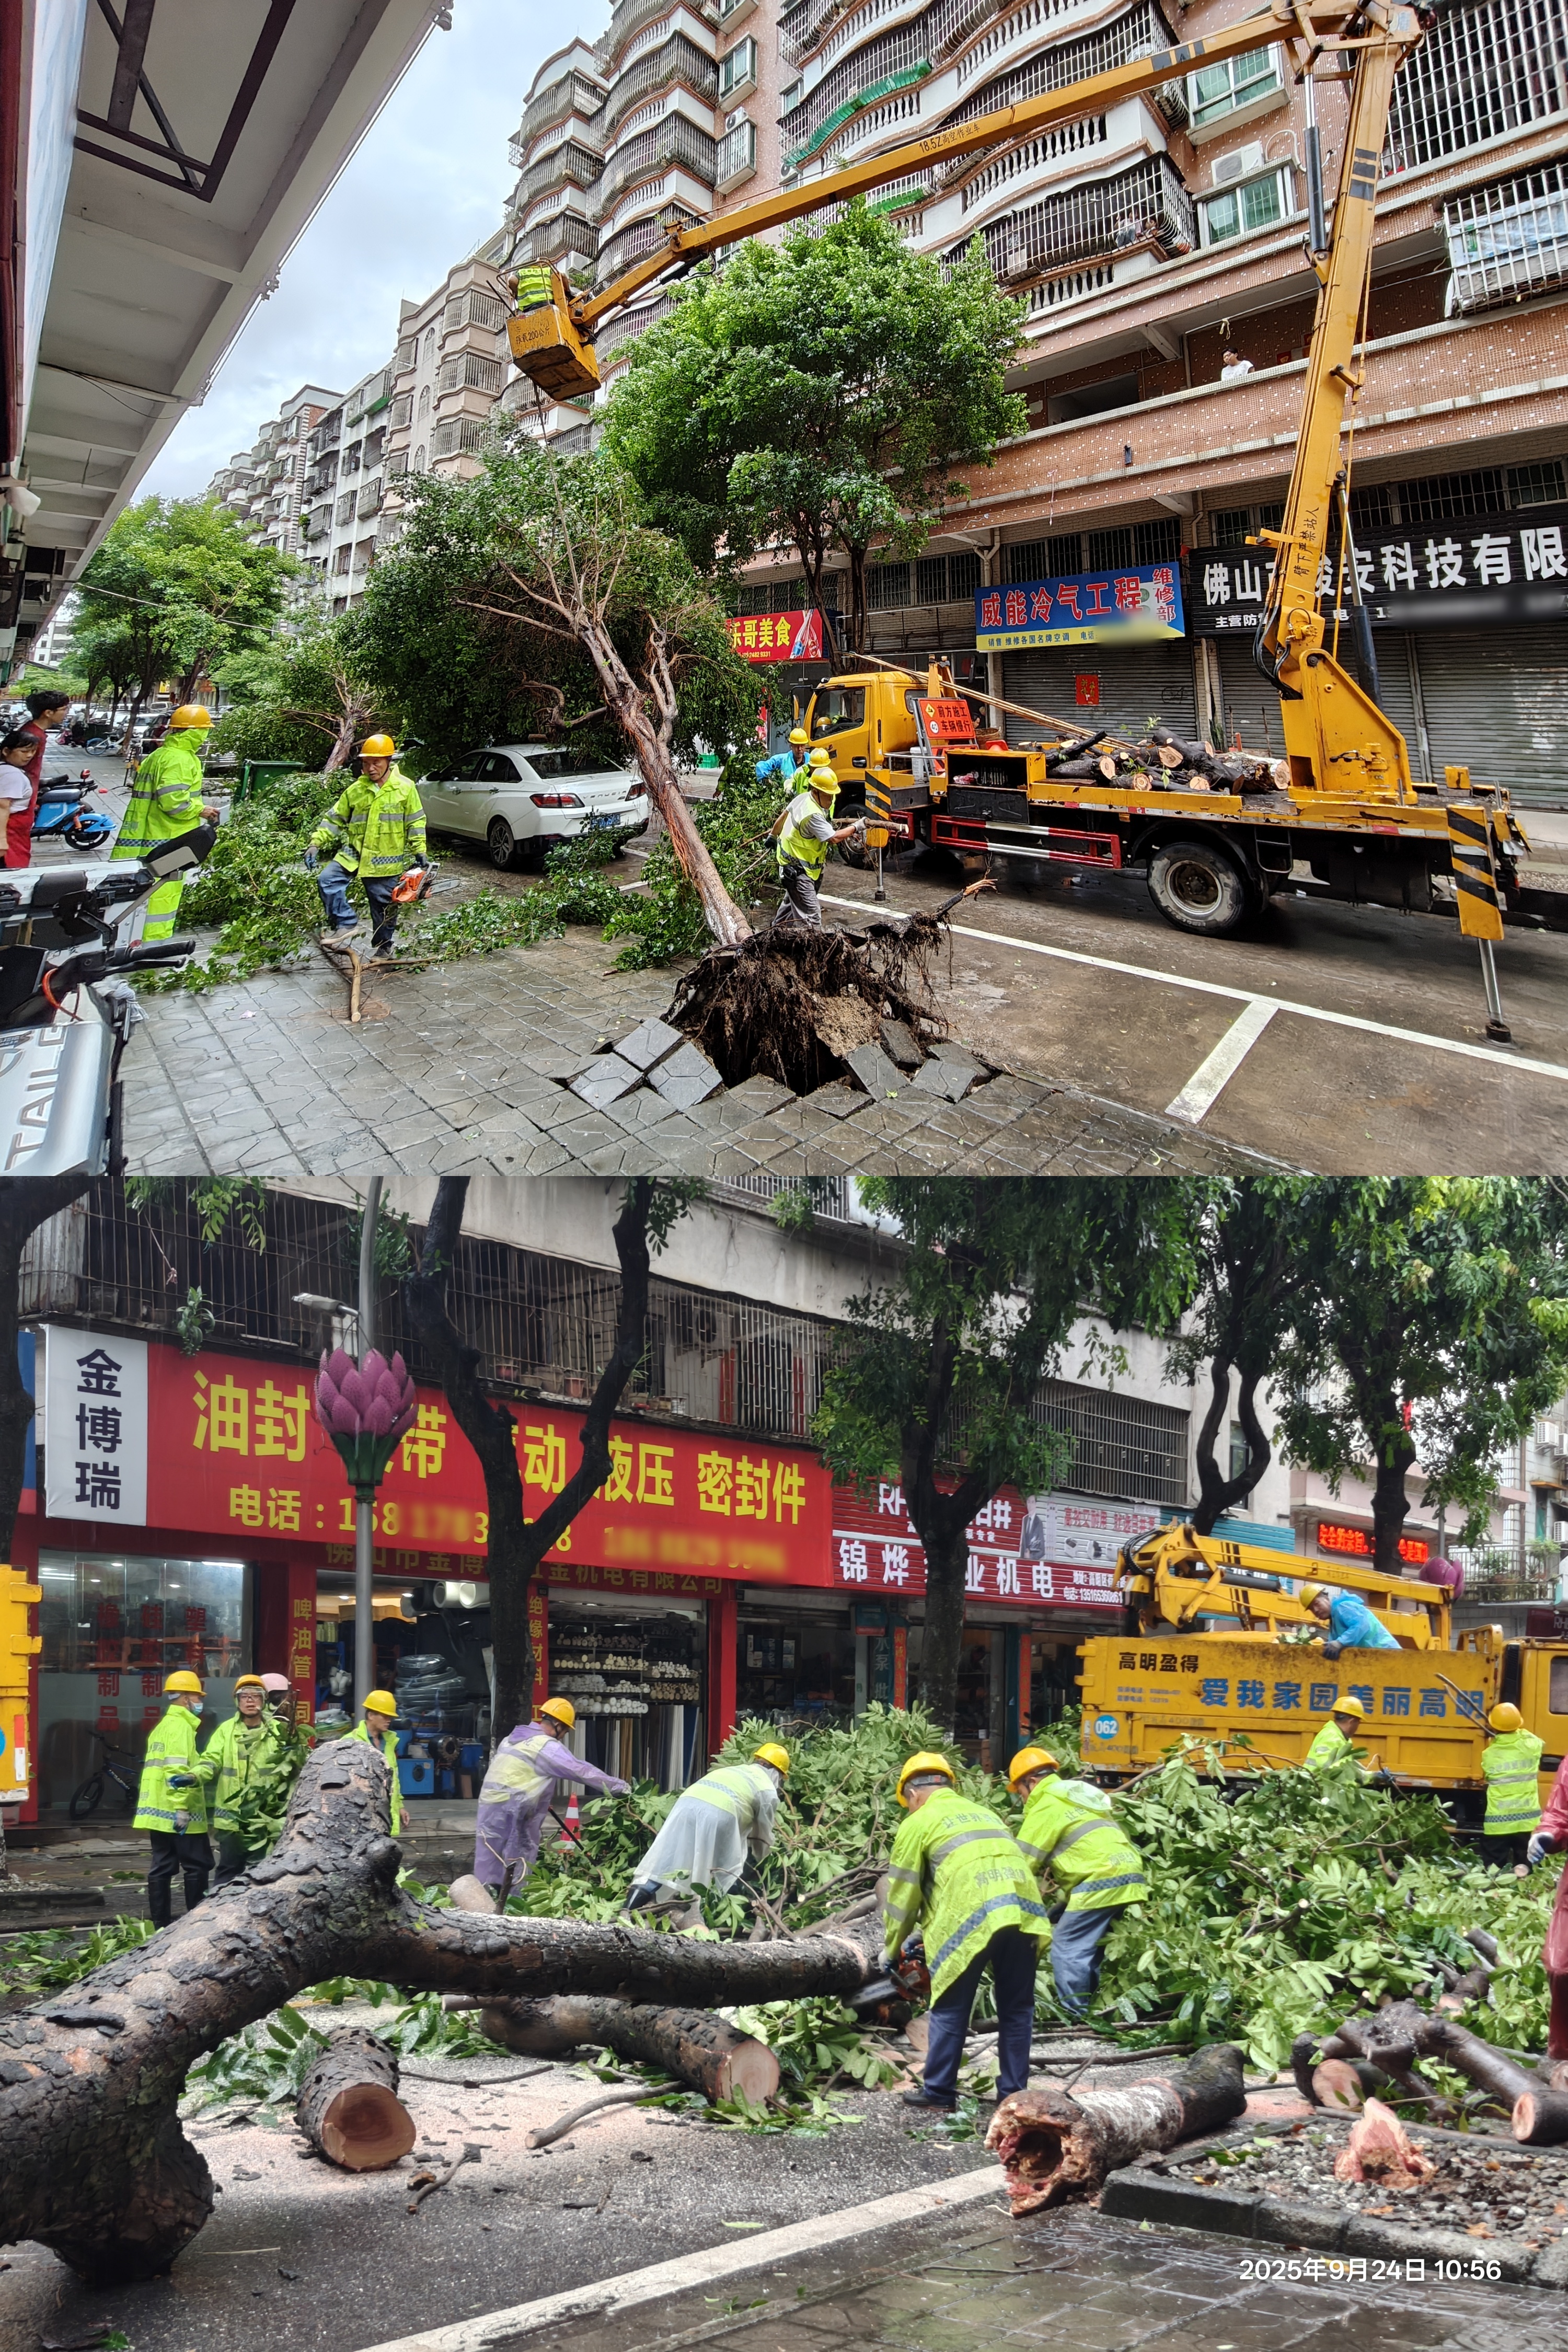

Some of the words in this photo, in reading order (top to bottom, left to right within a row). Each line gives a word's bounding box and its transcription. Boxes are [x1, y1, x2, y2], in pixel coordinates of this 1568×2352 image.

[919, 123, 980, 153] 18.5Z高空作业车
[1203, 526, 1567, 606] 佛山安科技有限
[1293, 506, 1320, 577] 臂下严禁站人
[981, 575, 1144, 627] 威能冷气工程
[1152, 567, 1177, 623] 维修部
[937, 705, 968, 718] 前方施工
[940, 719, 970, 732] 车辆慢行
[75, 1348, 122, 1510] 金博瑞
[192, 1370, 310, 1462] 油封
[594, 1434, 674, 1506] 液压
[697, 1450, 806, 1525] 密封件
[325, 1543, 723, 1594] 佛山市金博金机电有限公司
[839, 1539, 1055, 1599] 锦烨业机电
[1119, 1652, 1199, 1673] 高明盈得
[1200, 1677, 1483, 1719] 爱我家园美丽高明
[1095, 1720, 1117, 1734] 062
